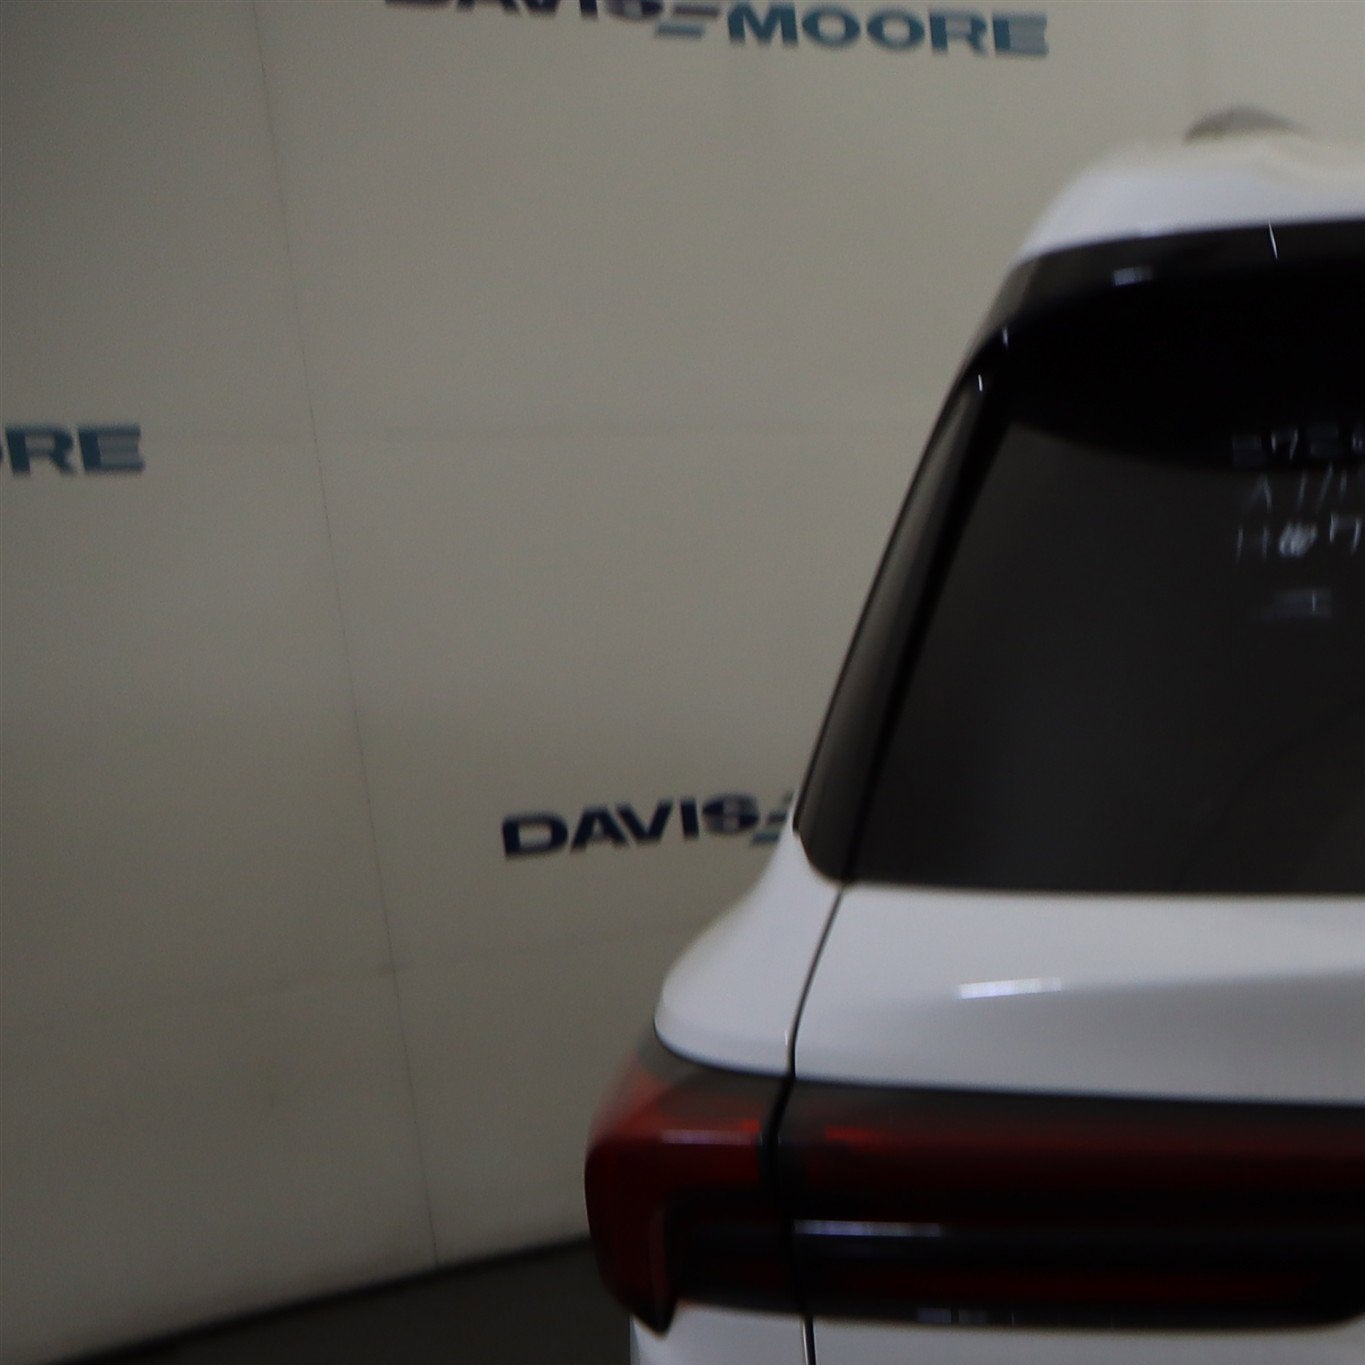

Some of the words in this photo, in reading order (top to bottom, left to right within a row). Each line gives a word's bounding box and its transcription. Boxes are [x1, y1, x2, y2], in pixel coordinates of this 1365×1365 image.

[728, 3, 1049, 58] MOORE
[0, 422, 146, 476] RE
[501, 793, 761, 860] DAVIS
